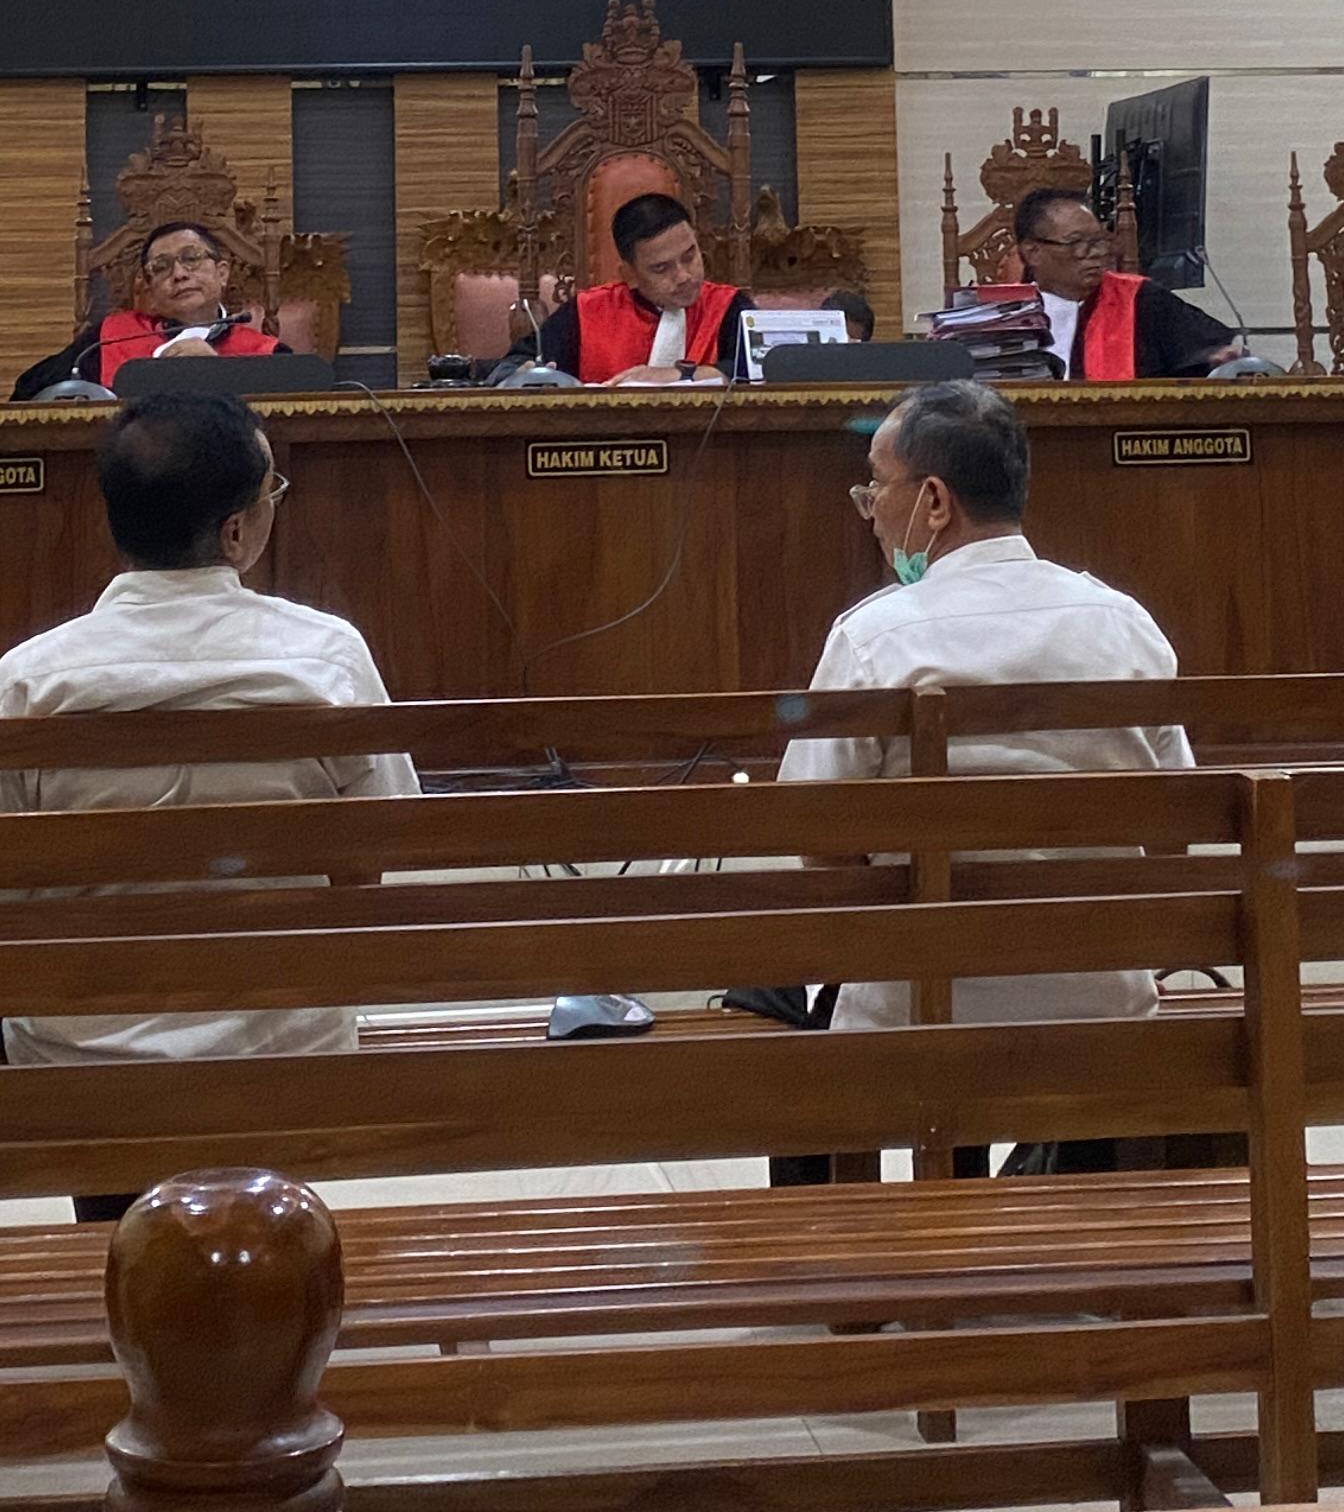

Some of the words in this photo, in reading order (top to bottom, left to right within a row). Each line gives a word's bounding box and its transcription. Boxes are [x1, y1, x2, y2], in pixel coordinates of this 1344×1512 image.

[1121, 439, 1170, 457] HAKIM
[1173, 437, 1243, 455] ANGGOTA
[536, 451, 594, 469] HAKIM
[599, 449, 659, 467] KETUA
